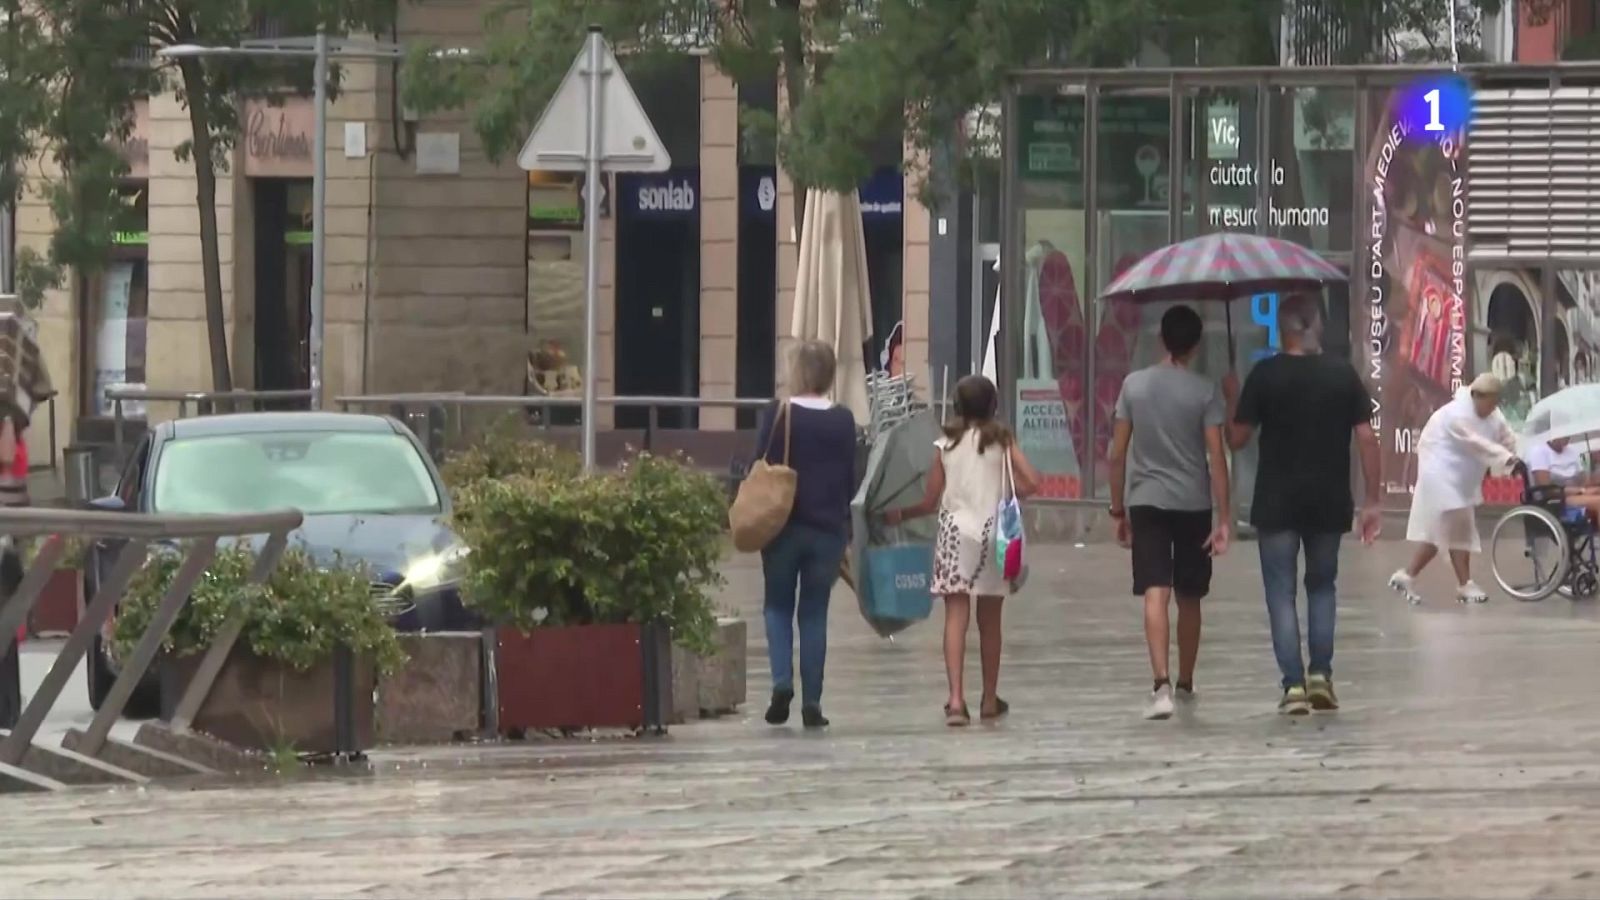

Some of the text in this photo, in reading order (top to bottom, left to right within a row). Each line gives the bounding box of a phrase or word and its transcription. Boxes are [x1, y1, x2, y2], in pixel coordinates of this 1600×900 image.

[1211, 116, 1240, 149] Vic,
[1210, 160, 1252, 185] ciutat
[1271, 158, 1284, 185] la
[638, 179, 695, 211] sonlab
[1269, 196, 1329, 226] humana
[1452, 177, 1464, 237] NOU
[1371, 205, 1383, 279] D'ART
[1371, 286, 1382, 379] MUSEU
